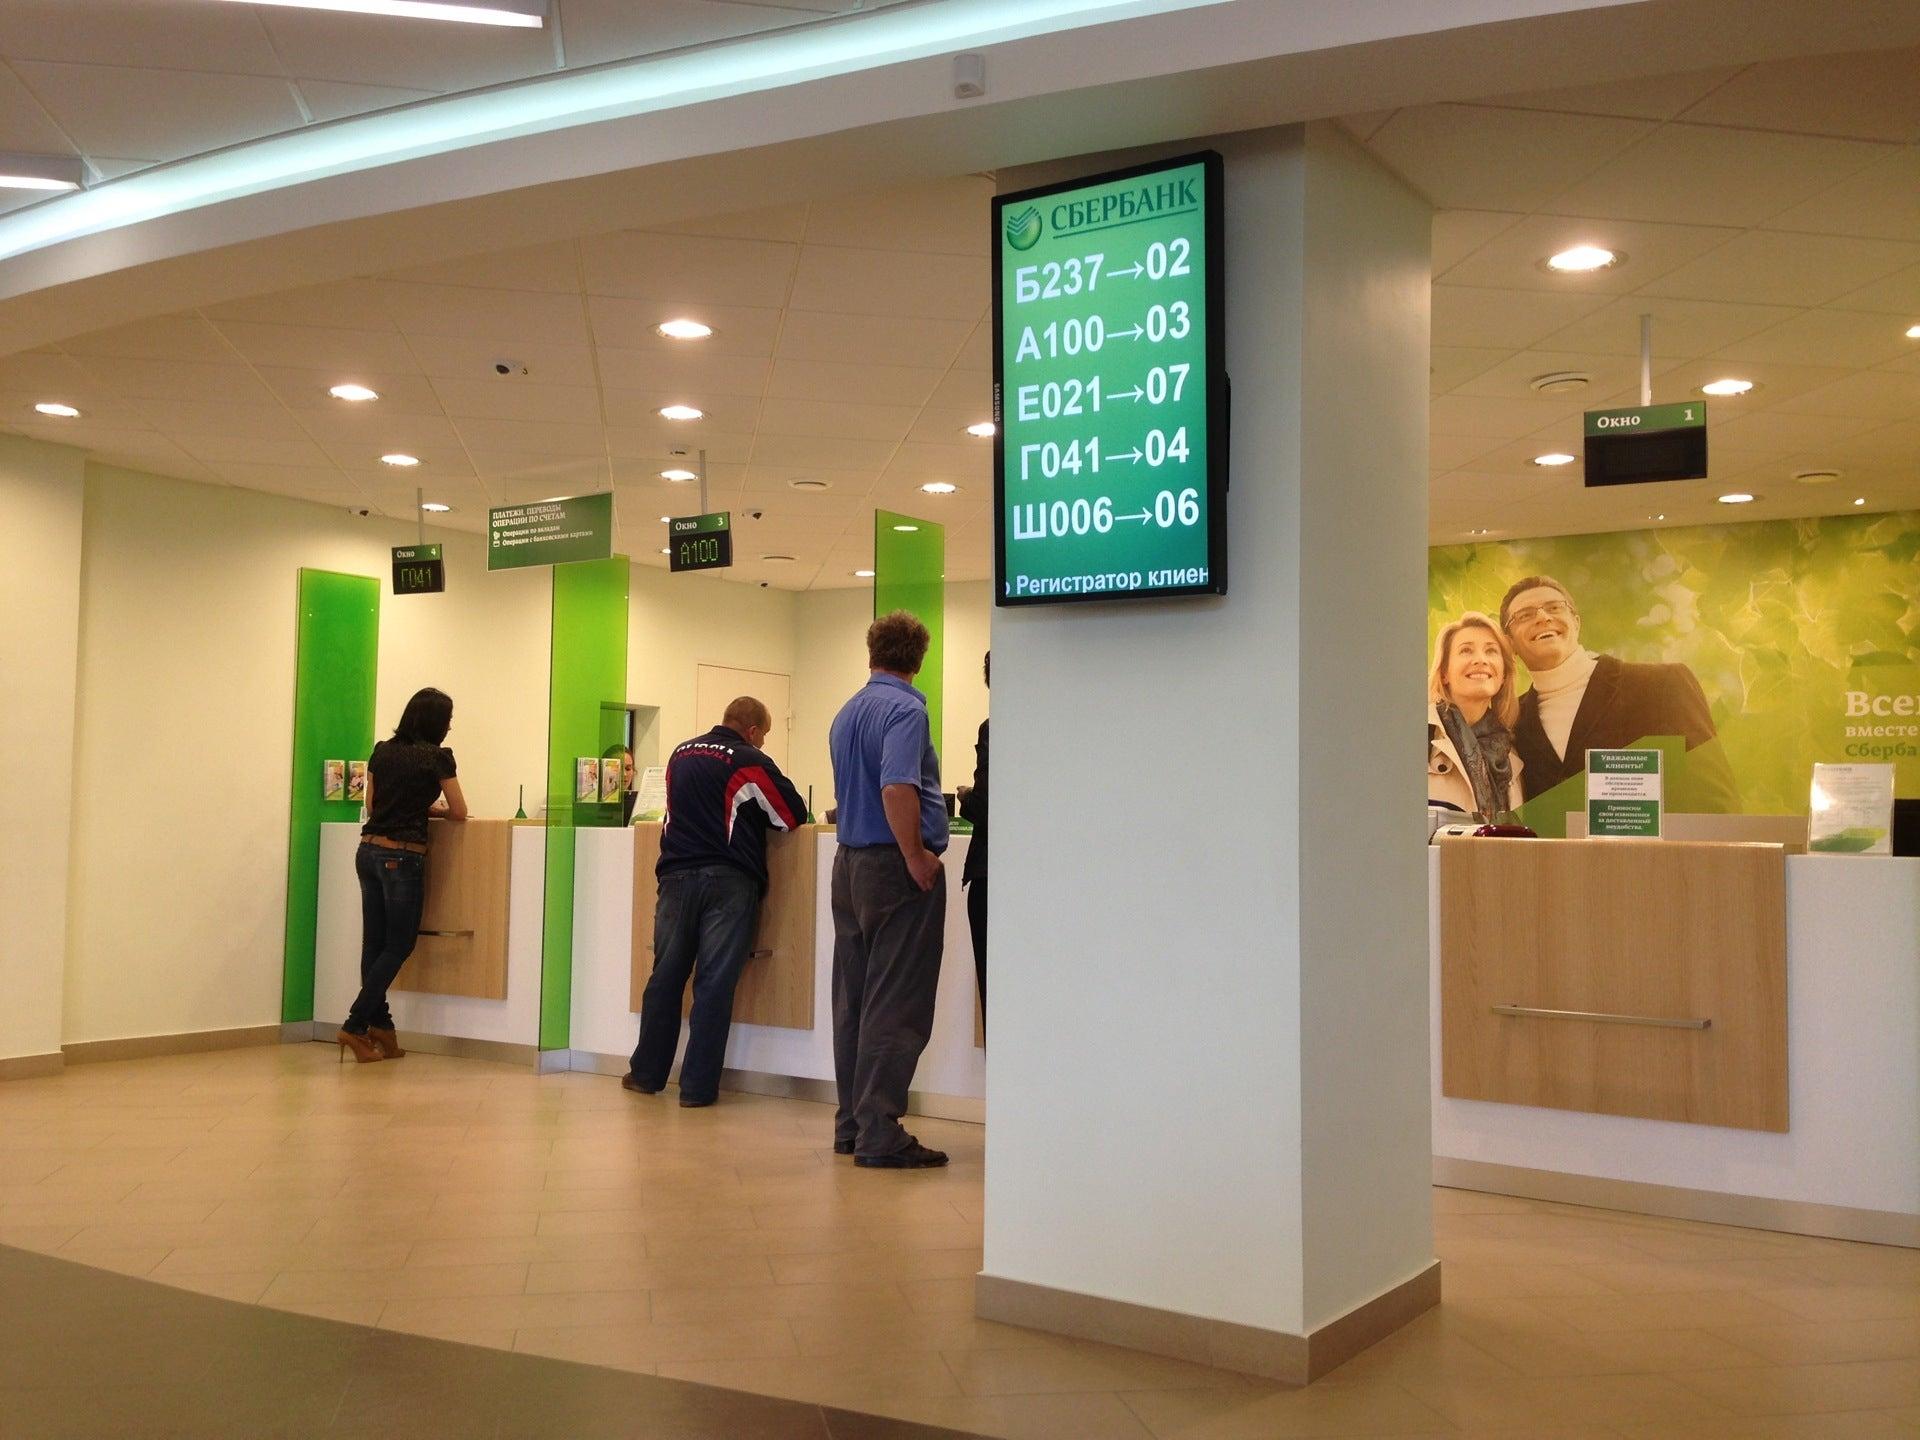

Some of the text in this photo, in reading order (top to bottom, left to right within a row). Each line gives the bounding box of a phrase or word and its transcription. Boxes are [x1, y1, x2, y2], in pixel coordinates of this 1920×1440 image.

[1051, 177, 1198, 231] СБЕРБАНК
[1015, 237, 1191, 305] Б237 02
[1015, 300, 1191, 363] А100 03
[1018, 363, 1190, 422] Е021 07
[1597, 408, 1694, 428] Окно 1
[1021, 426, 1190, 481] Г041 04
[492, 517, 528, 528] ОПЕРАЦИИ
[675, 517, 723, 531] Окно 3
[1013, 487, 1200, 540] Ш006 06
[396, 548, 436, 559] Окно 4
[680, 538, 718, 565] А100
[1016, 570, 1142, 595] Регистратор
[1845, 726, 1919, 737] вместе
